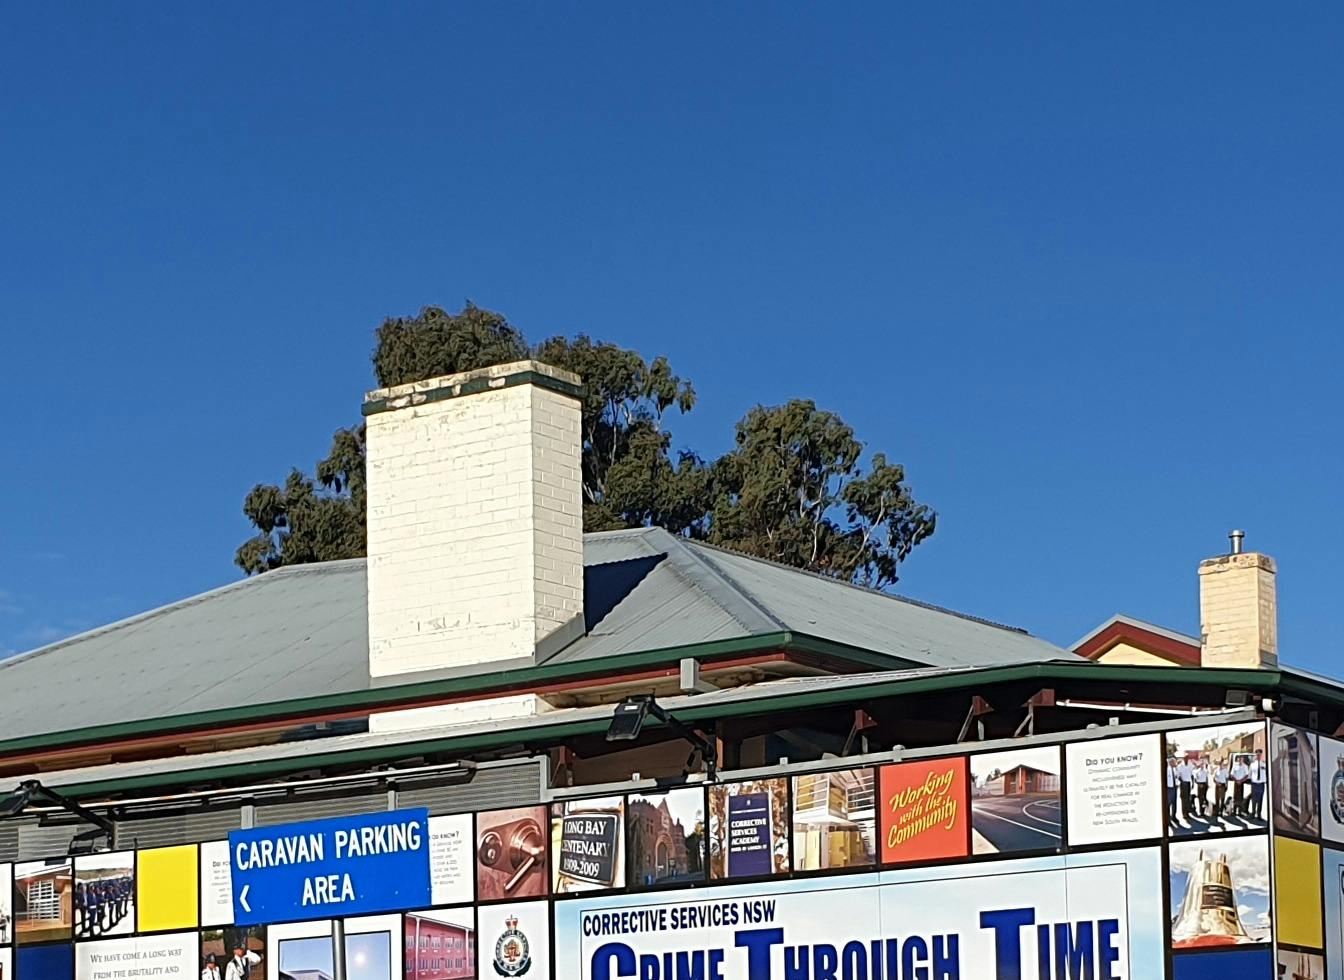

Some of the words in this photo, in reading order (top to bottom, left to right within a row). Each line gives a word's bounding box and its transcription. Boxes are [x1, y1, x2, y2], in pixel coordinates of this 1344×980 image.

[888, 768, 954, 812] Working
[899, 798, 923, 825] with
[925, 791, 942, 813] the
[585, 821, 607, 835] BAY
[888, 795, 957, 848] Community
[236, 833, 324, 871] CARAVAN
[335, 821, 421, 859] PARKING
[302, 873, 355, 906] AREA
[583, 909, 667, 936] CORRECTIVE
[671, 902, 739, 929] SERVICES
[743, 899, 776, 923] NSW
